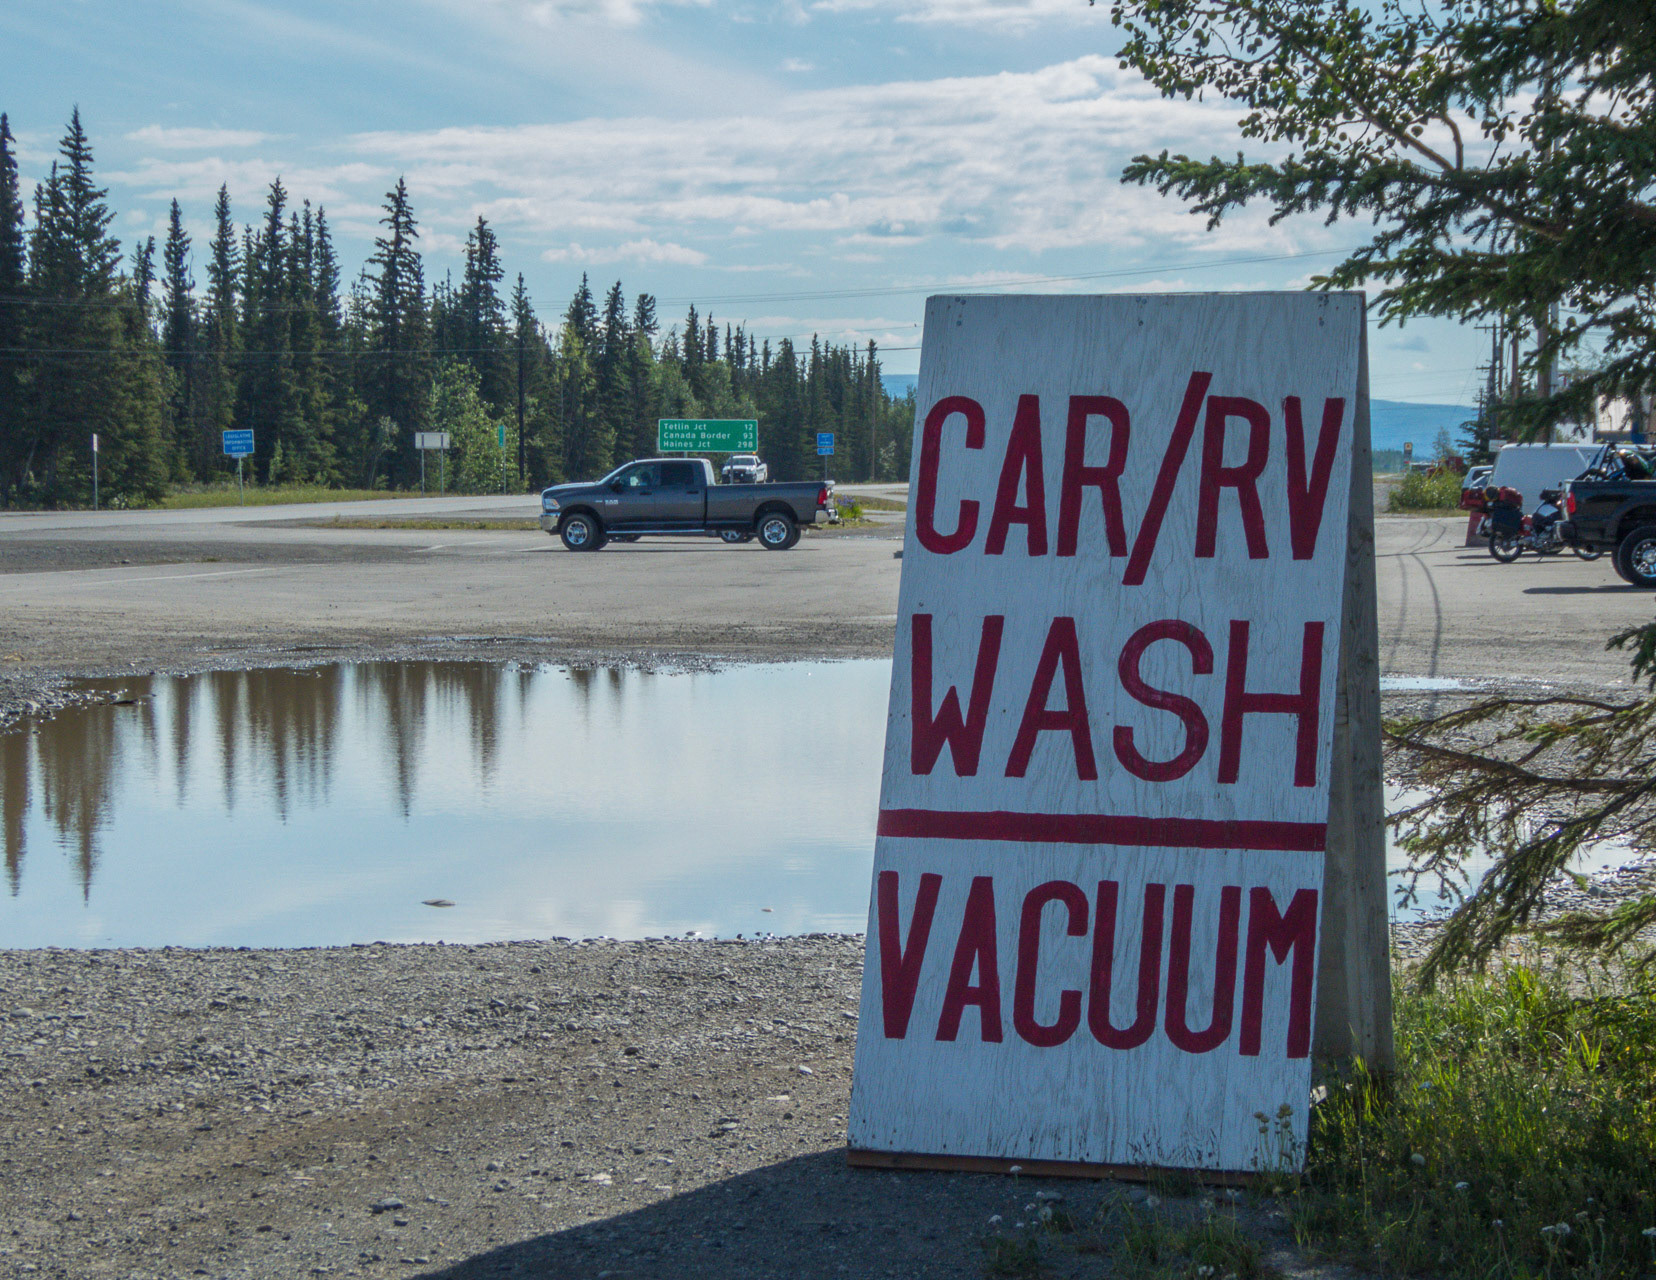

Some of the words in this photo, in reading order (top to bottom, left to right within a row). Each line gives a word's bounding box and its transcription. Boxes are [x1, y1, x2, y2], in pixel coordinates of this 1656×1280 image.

[744, 423, 753, 431] 12
[915, 371, 1346, 586] CAR/RV
[911, 613, 1325, 787] WASH
[877, 870, 1318, 1059] VACUUM
